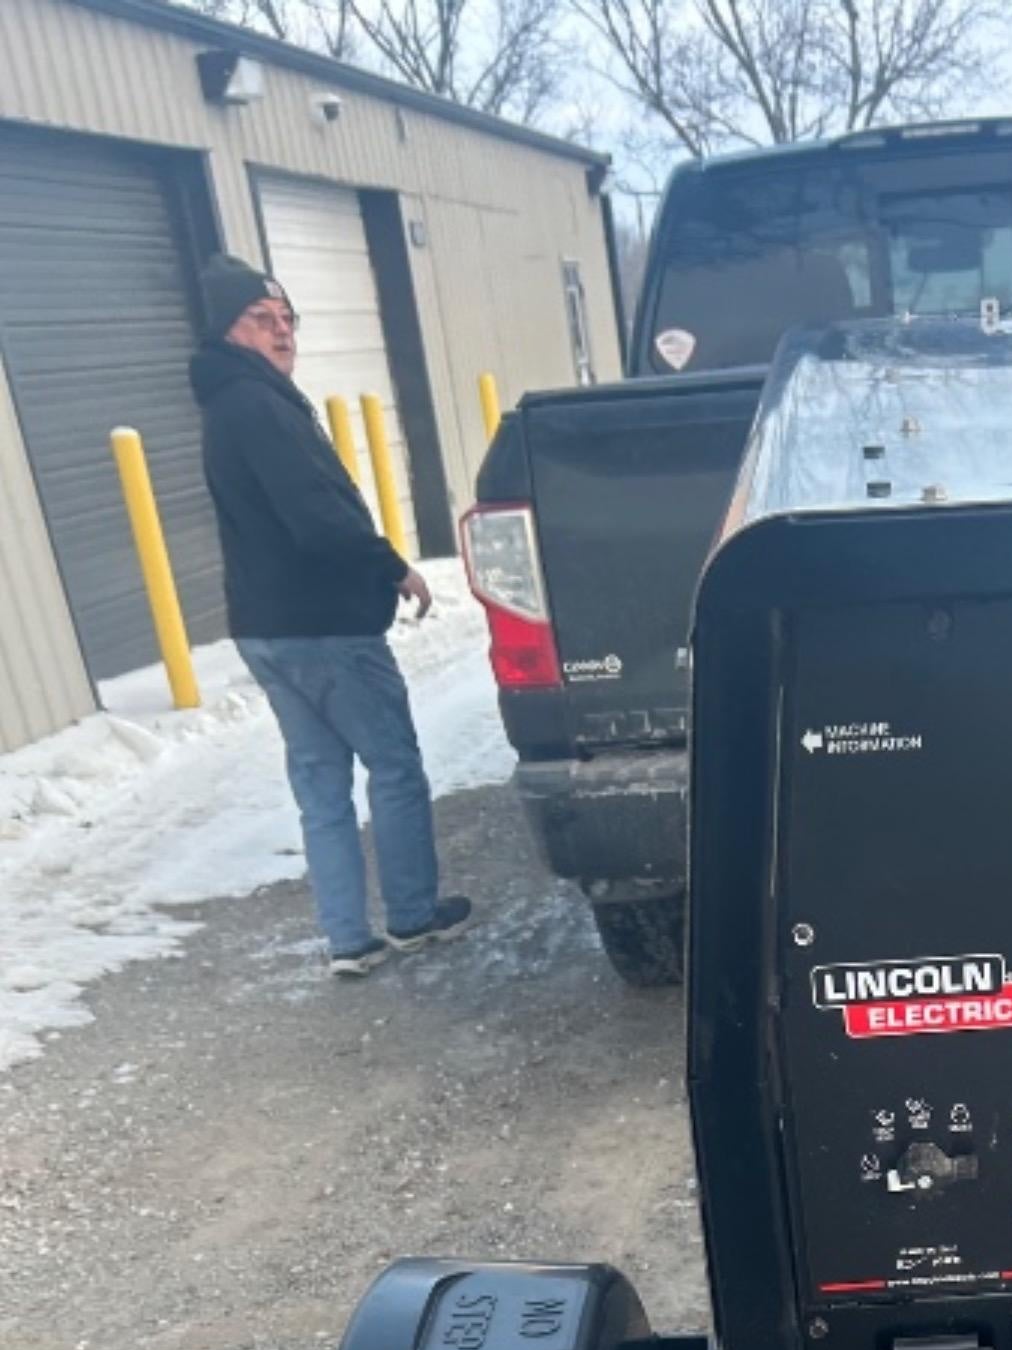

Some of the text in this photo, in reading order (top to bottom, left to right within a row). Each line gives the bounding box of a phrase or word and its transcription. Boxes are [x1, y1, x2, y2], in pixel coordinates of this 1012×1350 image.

[823, 722, 891, 739] MACHINE
[822, 961, 994, 1002] LINCOLN
[518, 1297, 568, 1339] NO
